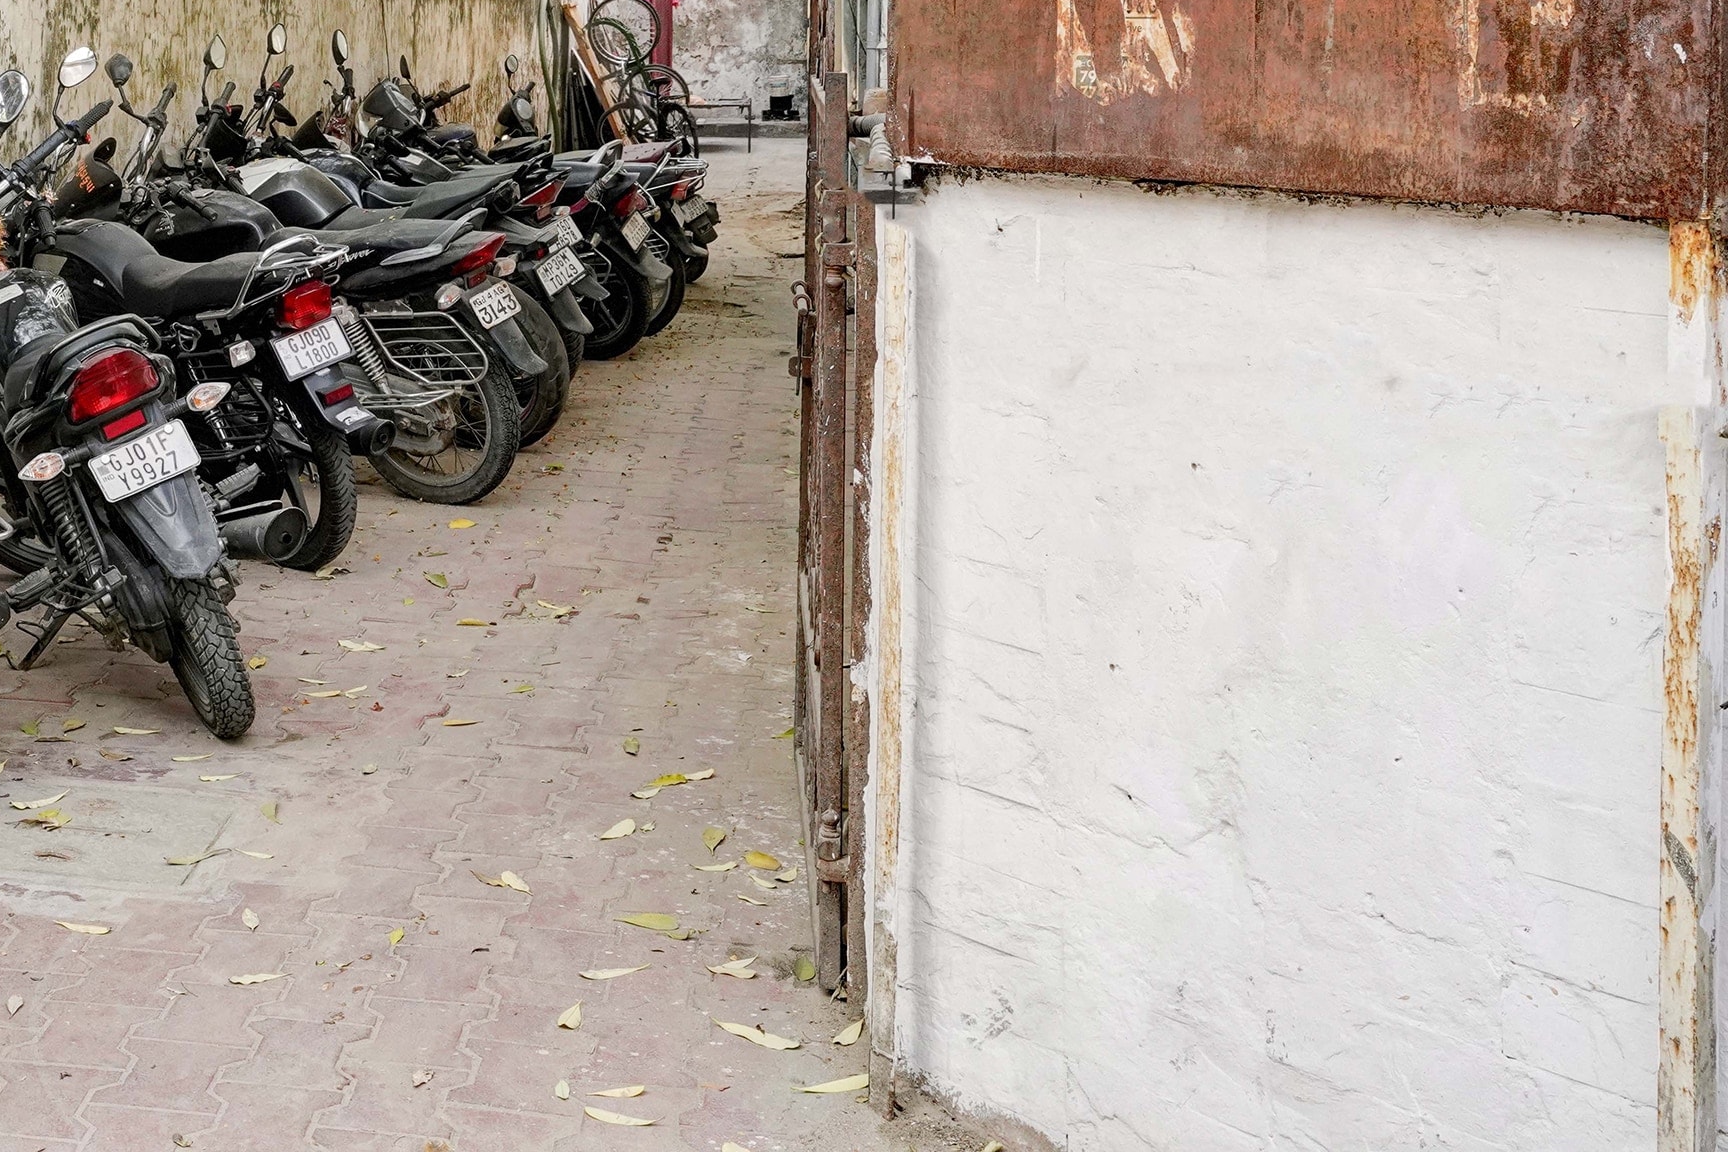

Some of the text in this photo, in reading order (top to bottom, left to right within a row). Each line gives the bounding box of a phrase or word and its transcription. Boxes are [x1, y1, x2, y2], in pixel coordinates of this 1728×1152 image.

[541, 252, 570, 279] MP36M
[550, 263, 579, 289] T0149
[478, 293, 517, 324] 3143
[287, 325, 331, 353] GJ09D
[295, 341, 339, 369] L1800
[108, 429, 168, 472] GJ01F
[117, 450, 178, 491] Y9927
